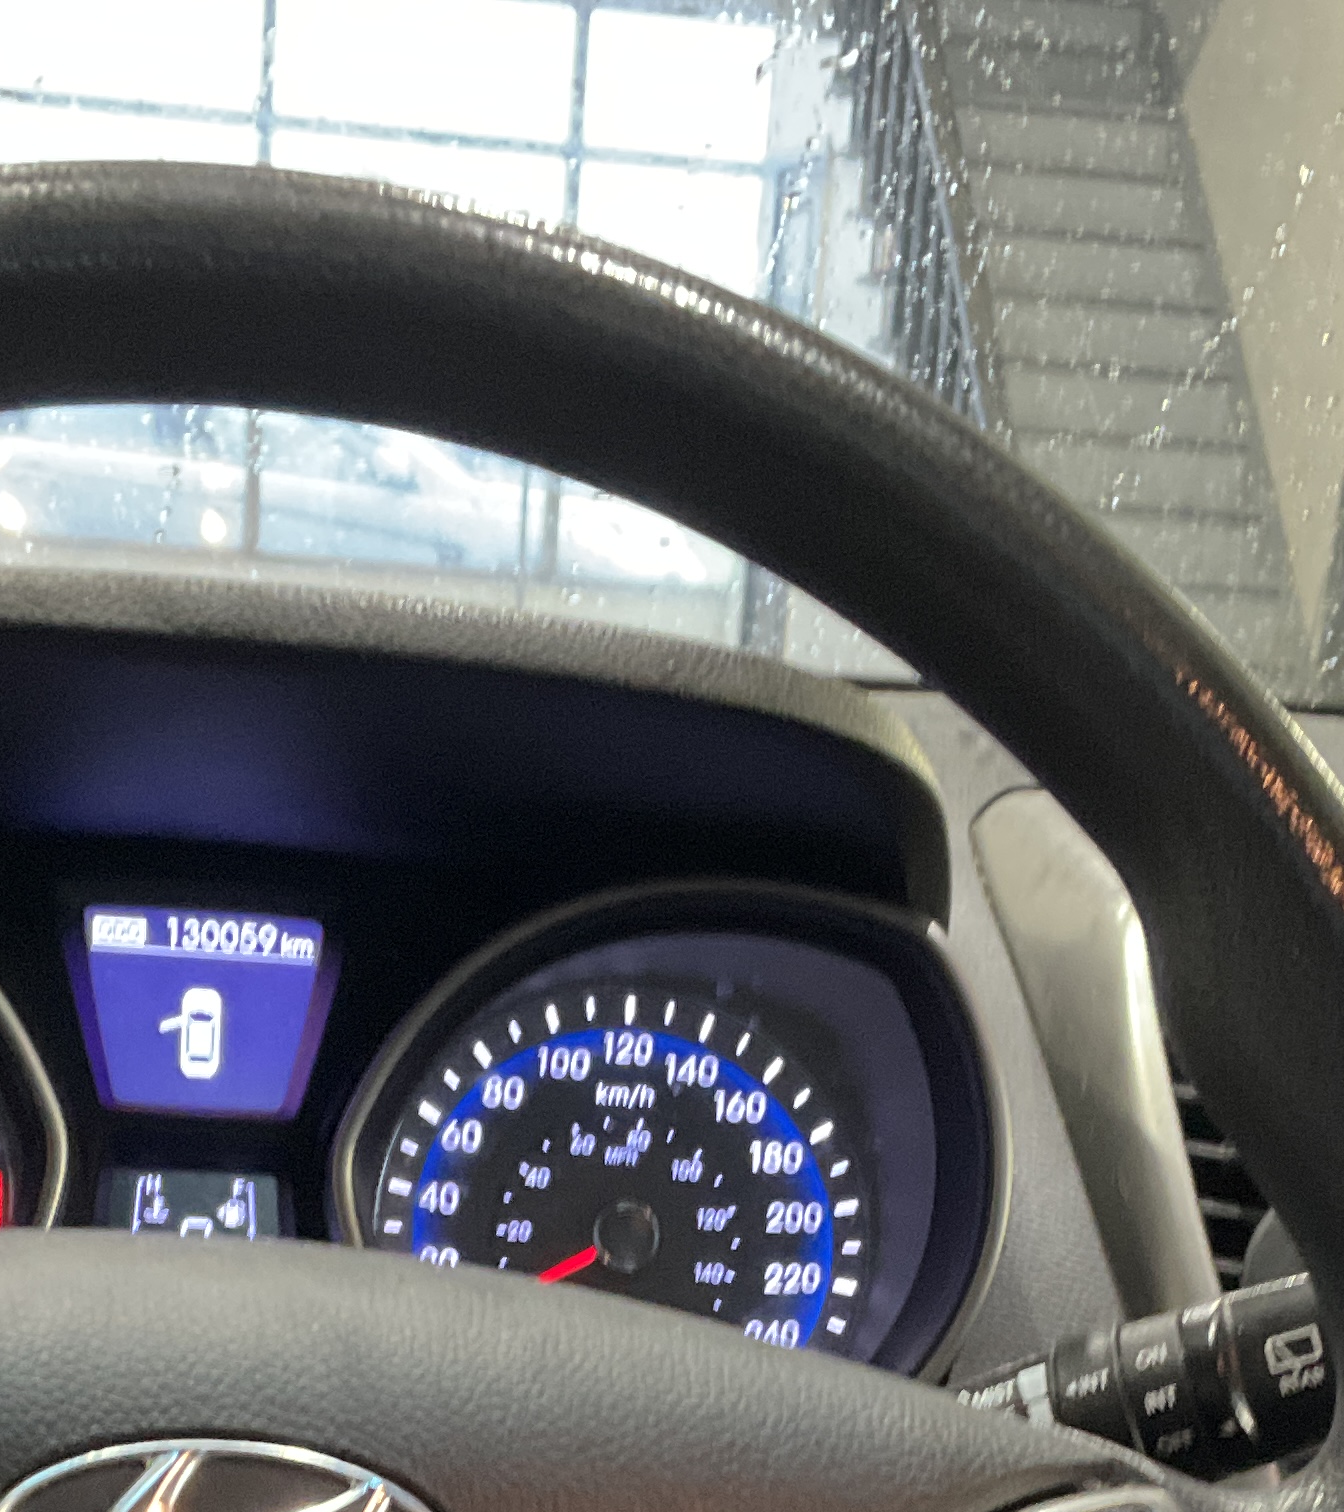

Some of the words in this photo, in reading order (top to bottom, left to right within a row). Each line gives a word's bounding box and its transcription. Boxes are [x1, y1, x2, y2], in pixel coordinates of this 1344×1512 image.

[167, 916, 278, 956] 130059
[280, 932, 315, 958] km
[537, 1046, 592, 1082] 100
[603, 1031, 654, 1067] 120
[664, 1052, 720, 1089] 140
[481, 1075, 526, 1110] 80
[594, 1081, 656, 1110] km/h
[714, 1090, 768, 1125] 160
[440, 1118, 483, 1154] 60
[671, 1158, 704, 1183] 100
[749, 1140, 804, 1175] 180
[524, 1165, 552, 1191] 40
[419, 1181, 460, 1215] 40
[697, 1207, 729, 1232] 120
[765, 1200, 824, 1236] 200
[694, 1261, 725, 1286] 140
[763, 1262, 822, 1296] 220
